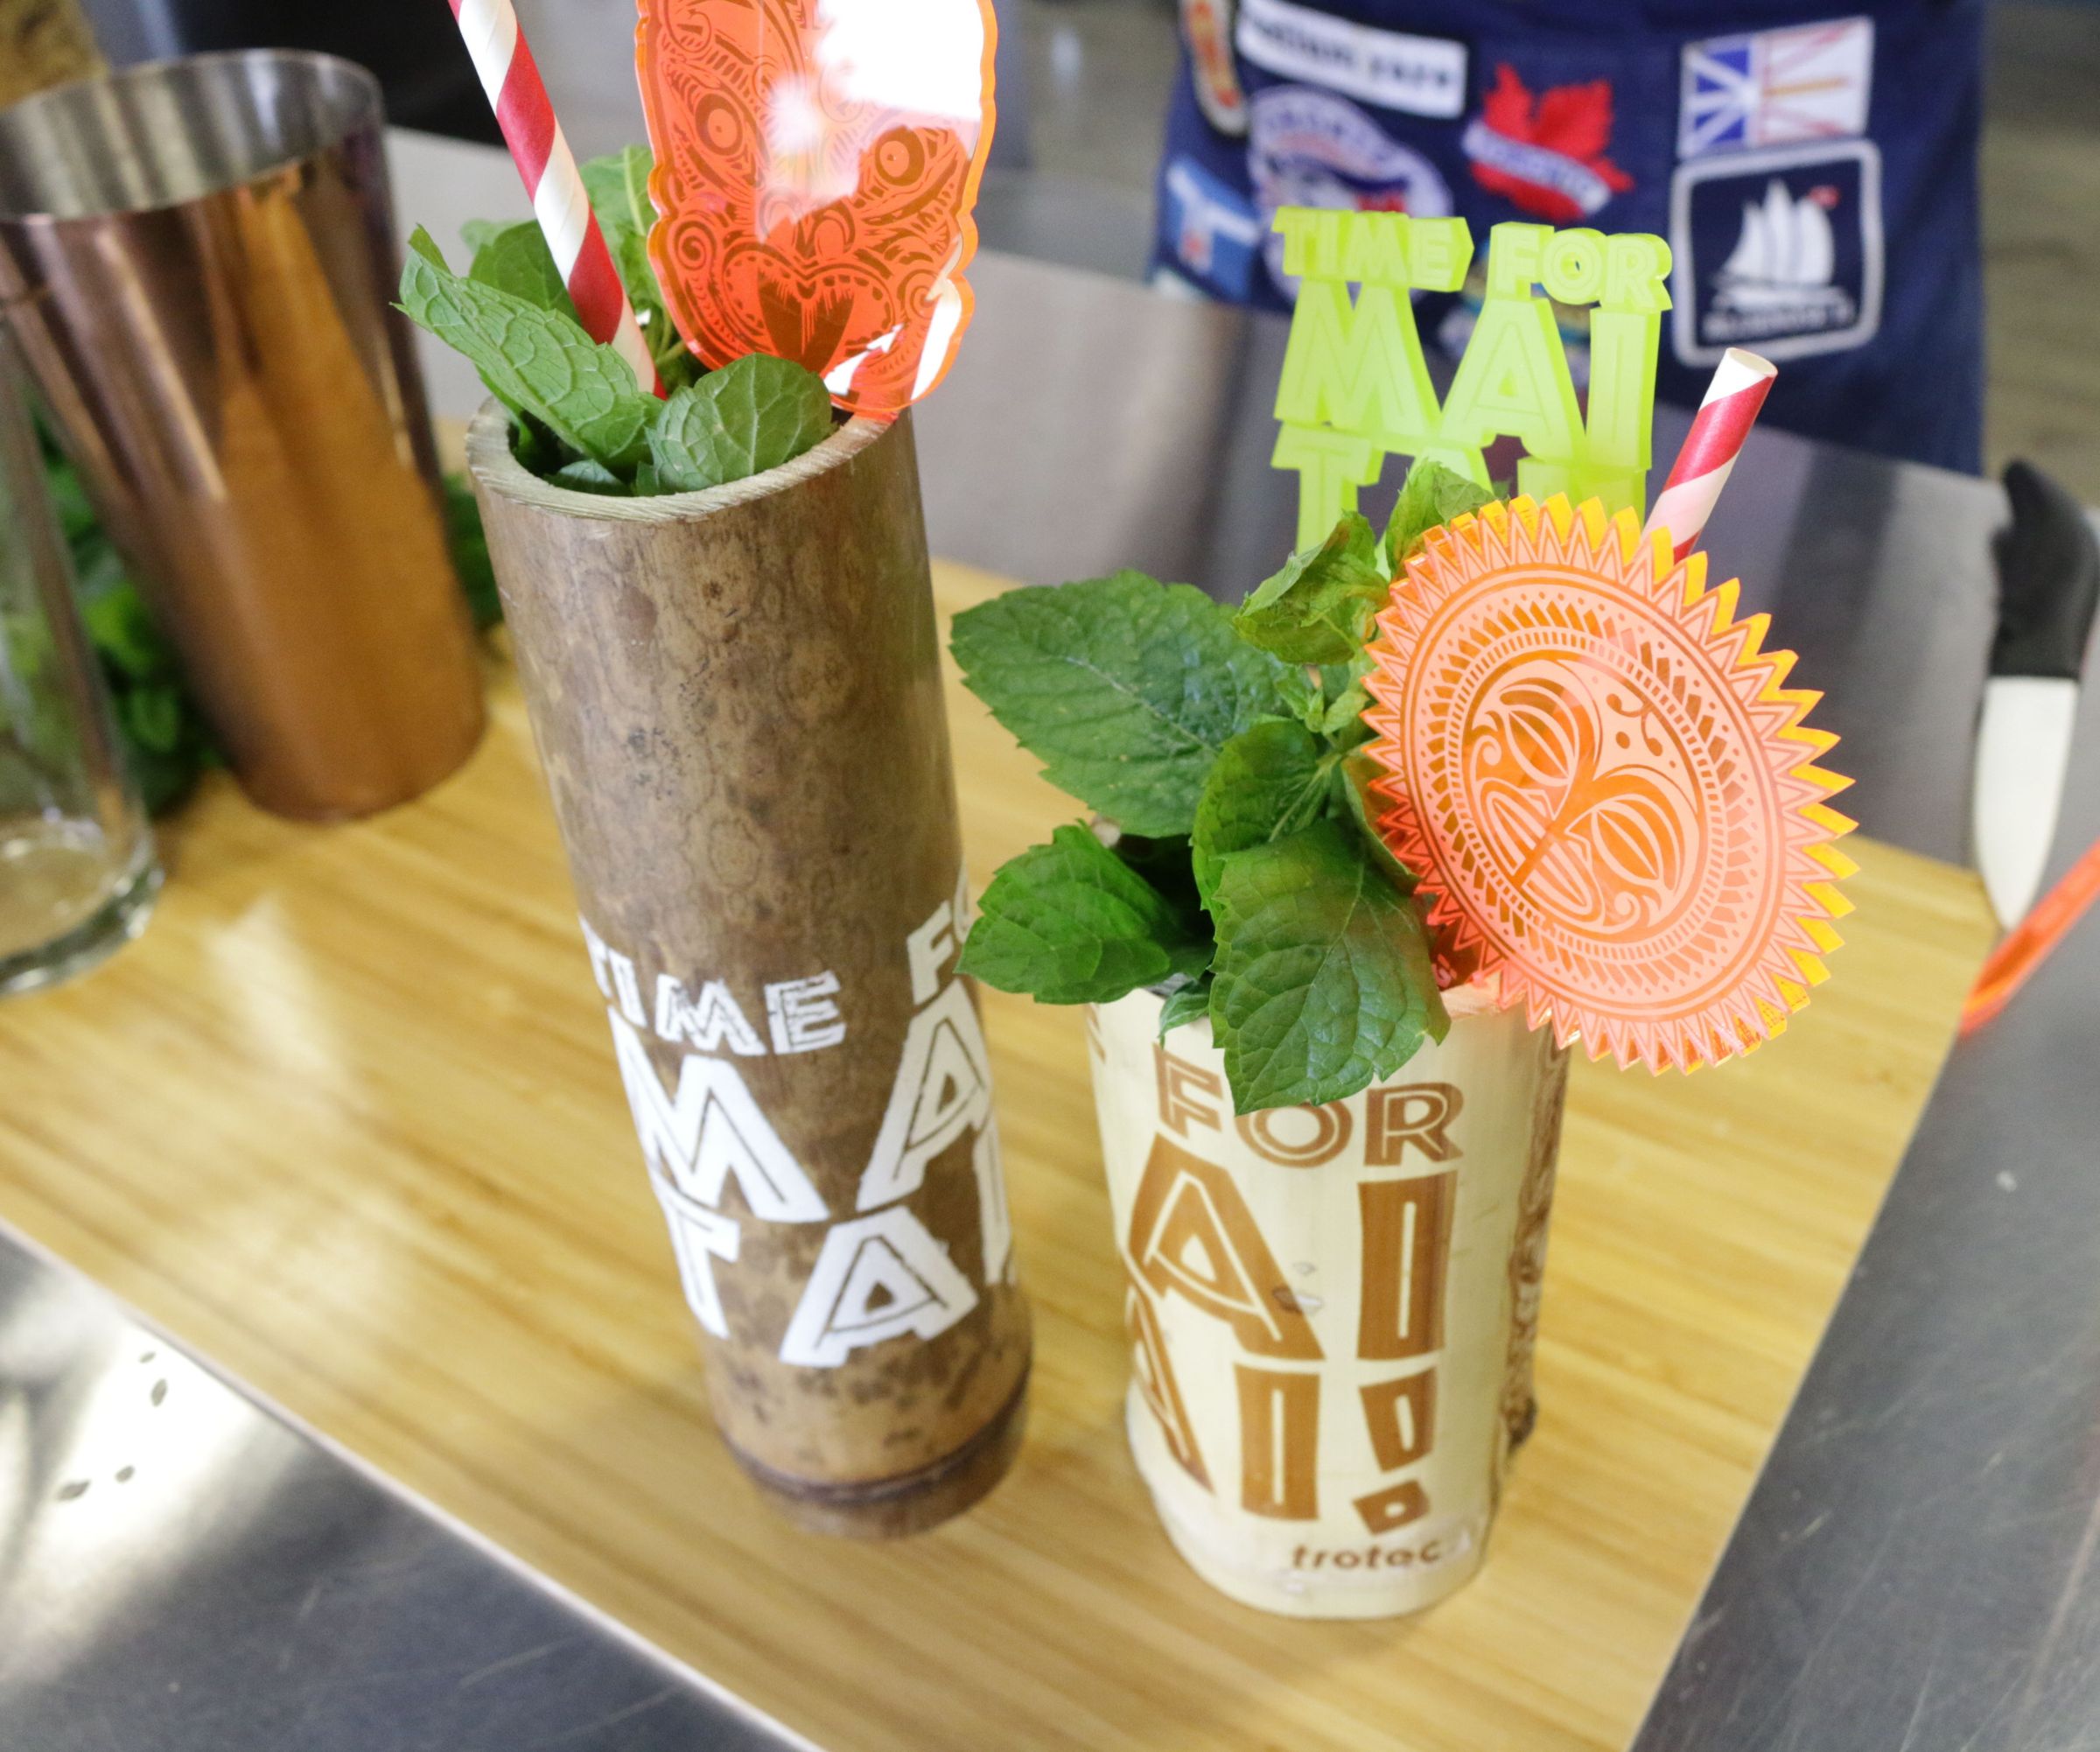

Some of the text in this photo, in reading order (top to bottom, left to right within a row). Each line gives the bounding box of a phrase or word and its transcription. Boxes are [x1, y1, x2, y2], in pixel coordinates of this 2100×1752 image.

[1272, 207, 1672, 312] TIME FOR
[1273, 279, 1662, 471] MAI
[1152, 1041, 1465, 1169] FOR
[1293, 1540, 1441, 1569] trotec
